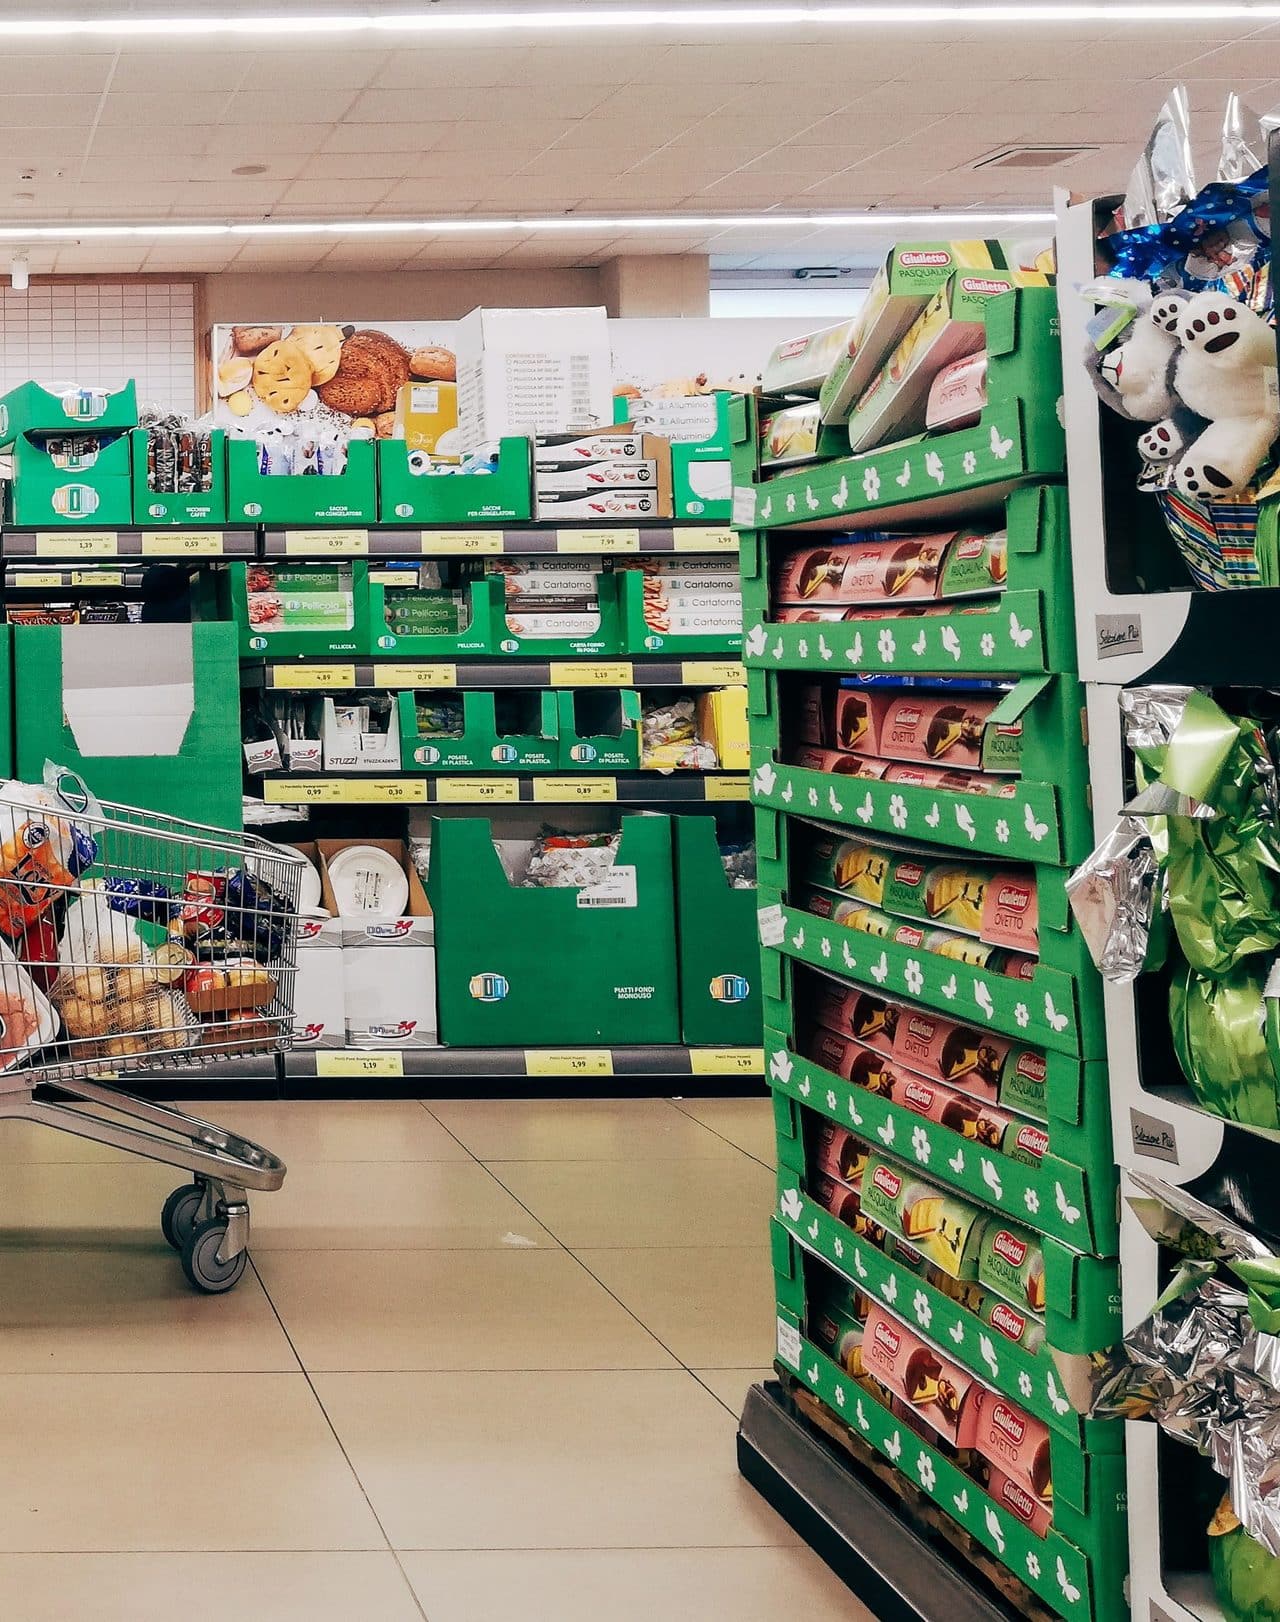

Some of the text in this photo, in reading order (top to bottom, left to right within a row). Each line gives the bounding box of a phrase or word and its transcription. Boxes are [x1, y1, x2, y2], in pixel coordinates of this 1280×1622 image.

[670, 417, 710, 425] Alluminio
[670, 432, 711, 440] Alluminio
[465, 540, 479, 548] 2,79
[542, 560, 591, 571] Cartaforno
[682, 560, 733, 571] Cartaforno
[294, 572, 332, 582] Pellicola
[543, 579, 592, 590] Cartaforno
[684, 579, 734, 590] Cartaforno
[301, 600, 341, 610] Pellicola
[411, 608, 449, 618] Pellicola
[545, 617, 595, 628] Cartaforno
[411, 624, 449, 634] Pellicola
[726, 670, 741, 679] 1,79
[307, 787, 322, 797] 0,99
[480, 786, 495, 796] 0,89
[576, 786, 592, 796] 0,89
[994, 912, 1024, 930] OVETTO
[614, 986, 656, 995] PIATTI FONDI
[617, 993, 653, 1001] MONOUSO
[904, 1039, 930, 1058] OVETTO
[362, 1061, 378, 1070] 1,19
[571, 1060, 588, 1069] 1,99
[736, 1058, 753, 1068] 1,99
[873, 1167, 901, 1196] Giulietta
[994, 1234, 1026, 1264] Giulietta
[992, 1306, 1025, 1338] Giulietta
[871, 1345, 896, 1372] OVETTO
[993, 1405, 1024, 1439] Giulietta
[989, 1430, 1019, 1462] OVETTO
[1003, 1479, 1034, 1515] Giulietta
